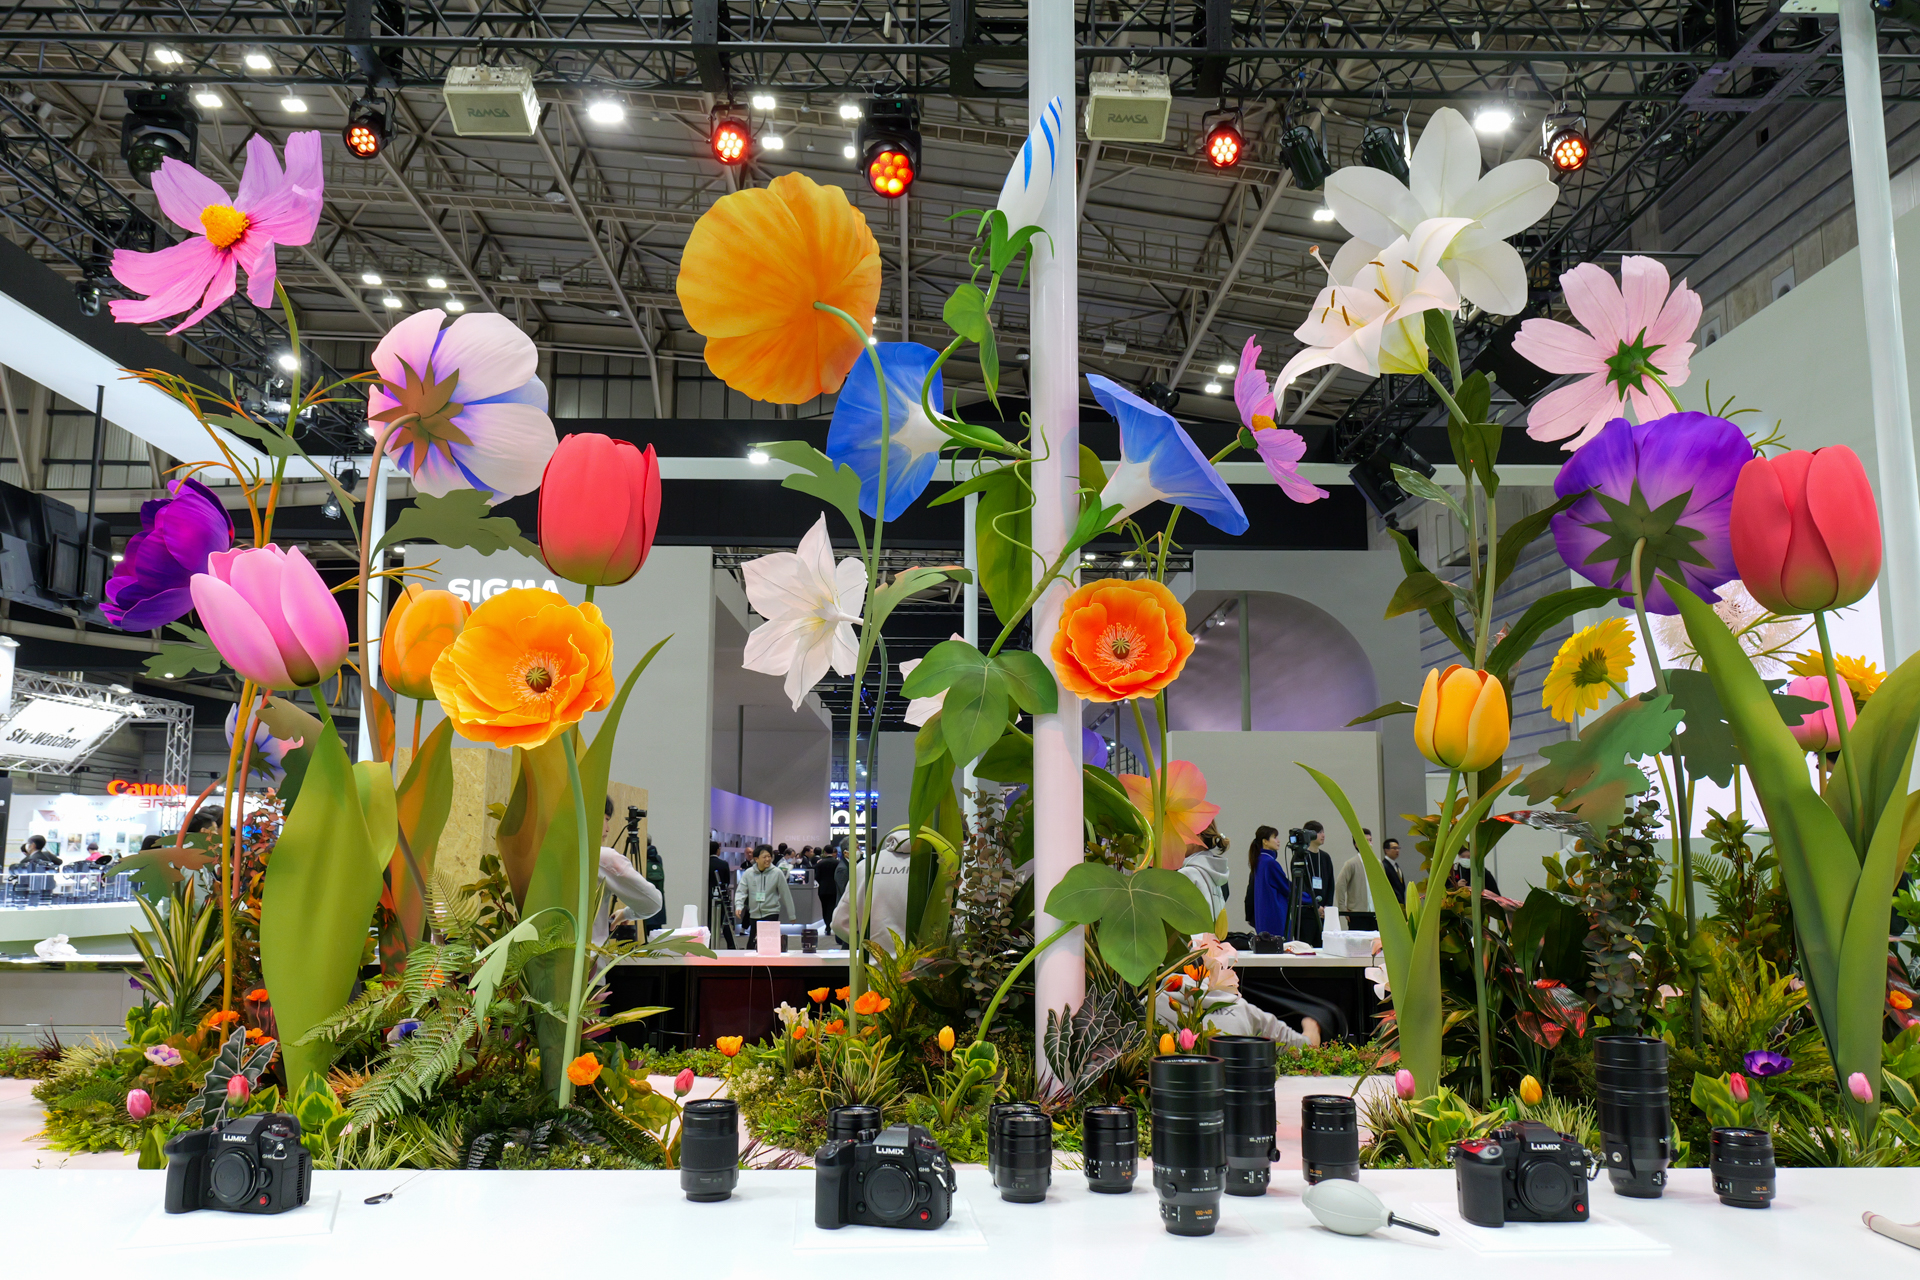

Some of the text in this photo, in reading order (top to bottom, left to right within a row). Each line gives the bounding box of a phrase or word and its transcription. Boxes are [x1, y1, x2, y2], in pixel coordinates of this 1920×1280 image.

[467, 107, 511, 118] RAMSA
[1107, 113, 1148, 124] RAMSA
[6, 728, 81, 749] Sky-Watcher
[223, 1133, 247, 1142] LUMIX
[876, 1145, 905, 1155] LUMIX
[1531, 1142, 1561, 1151] LUMIX
